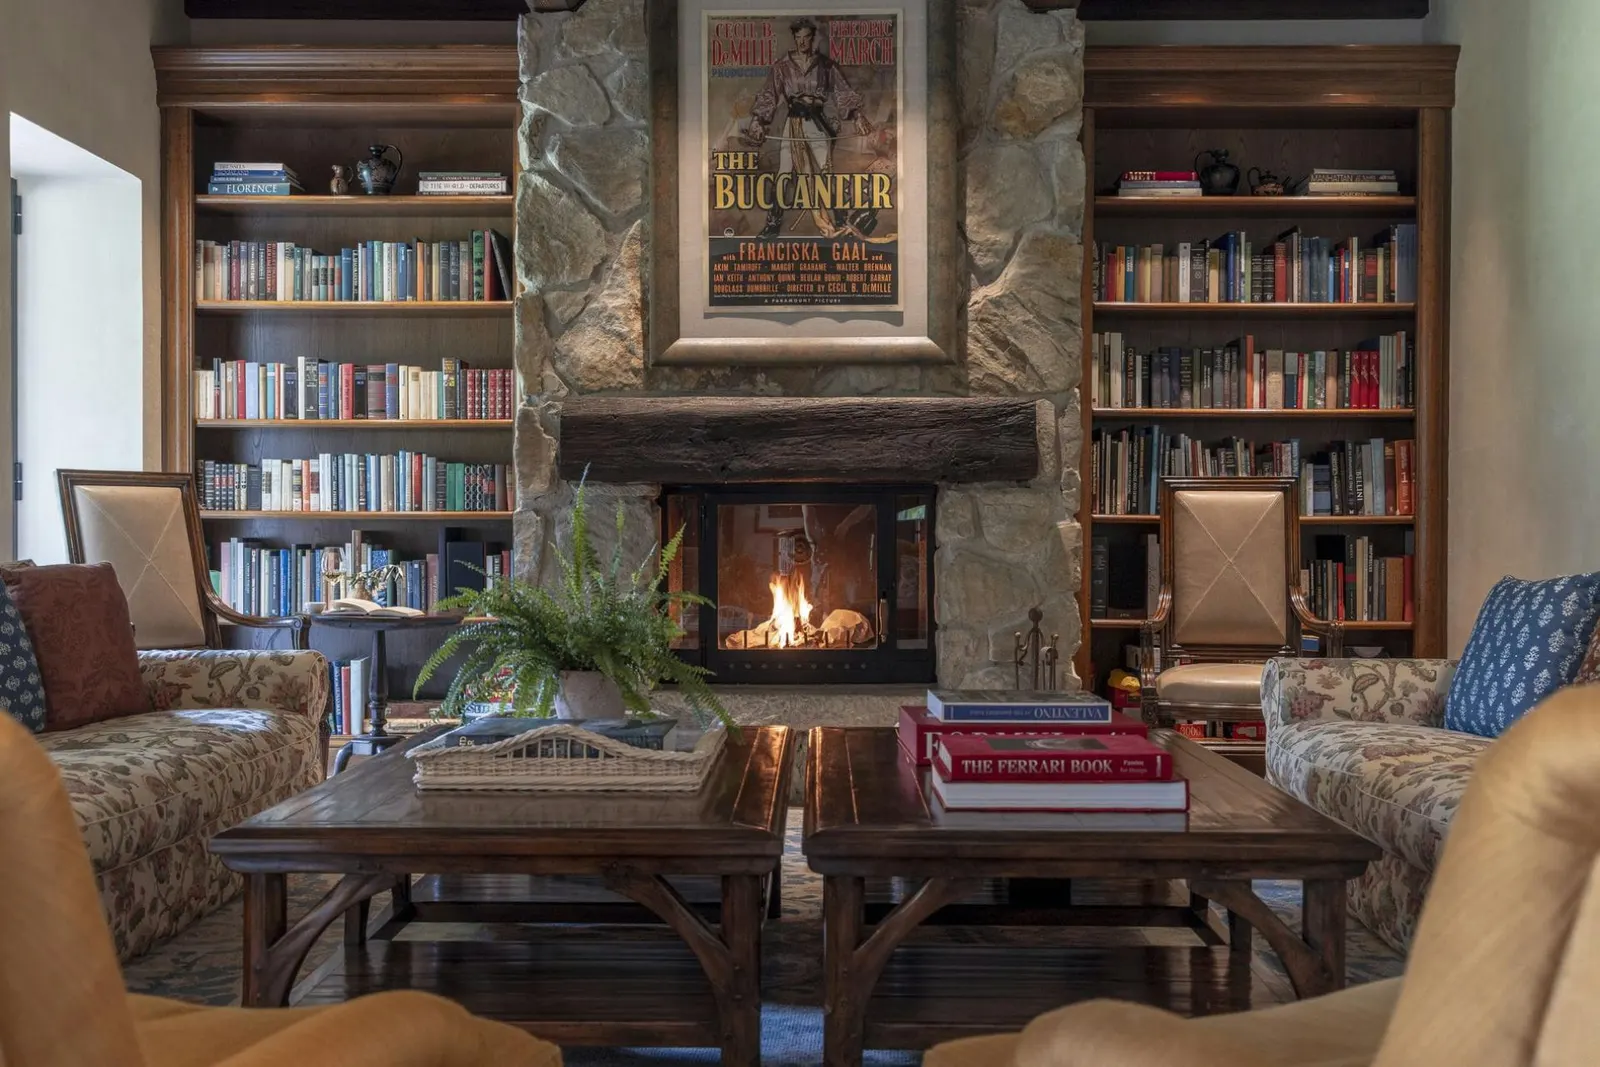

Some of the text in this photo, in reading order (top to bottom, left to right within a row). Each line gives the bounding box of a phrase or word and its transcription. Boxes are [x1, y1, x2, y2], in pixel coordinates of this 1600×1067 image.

[715, 22, 756, 38] CECIL
[829, 37, 893, 65] MARCH
[714, 152, 759, 170] THE
[226, 183, 277, 193] FLORENCE
[714, 173, 894, 209] BUCCANEER
[739, 242, 819, 261] FRANCISKA
[832, 242, 868, 261] GAAL
[1034, 702, 1104, 719] VALENTINO
[962, 759, 1113, 774] THE FERRARI BOOK
